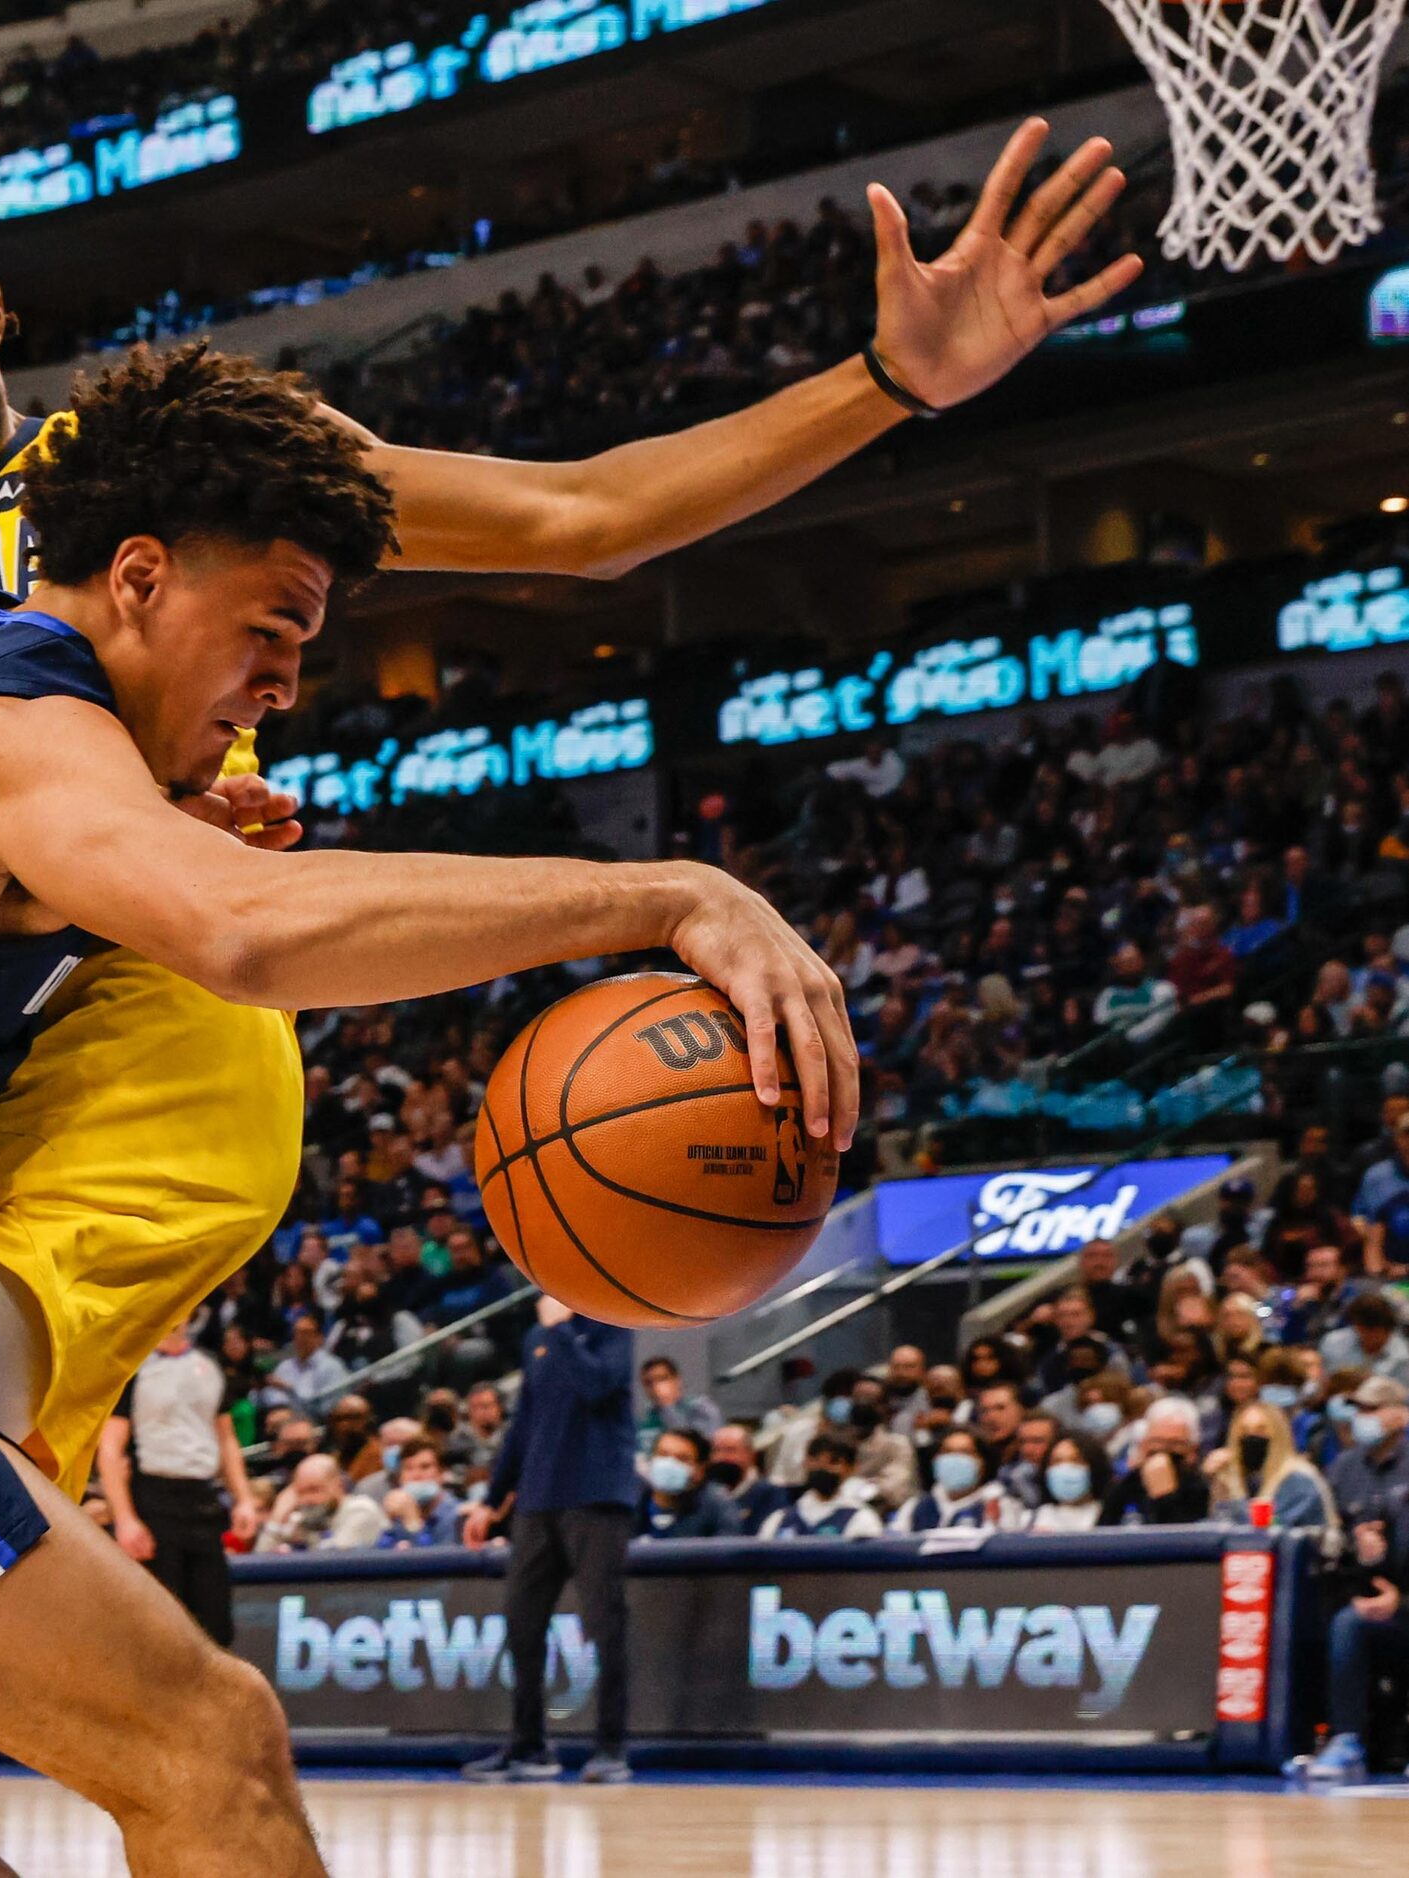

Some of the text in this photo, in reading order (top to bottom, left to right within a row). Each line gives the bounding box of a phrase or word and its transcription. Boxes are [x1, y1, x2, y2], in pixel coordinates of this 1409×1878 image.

[687, 1144, 724, 1160] OFFICIAL
[972, 1170, 1140, 1256] Ford
[747, 1584, 1162, 1719] betway
